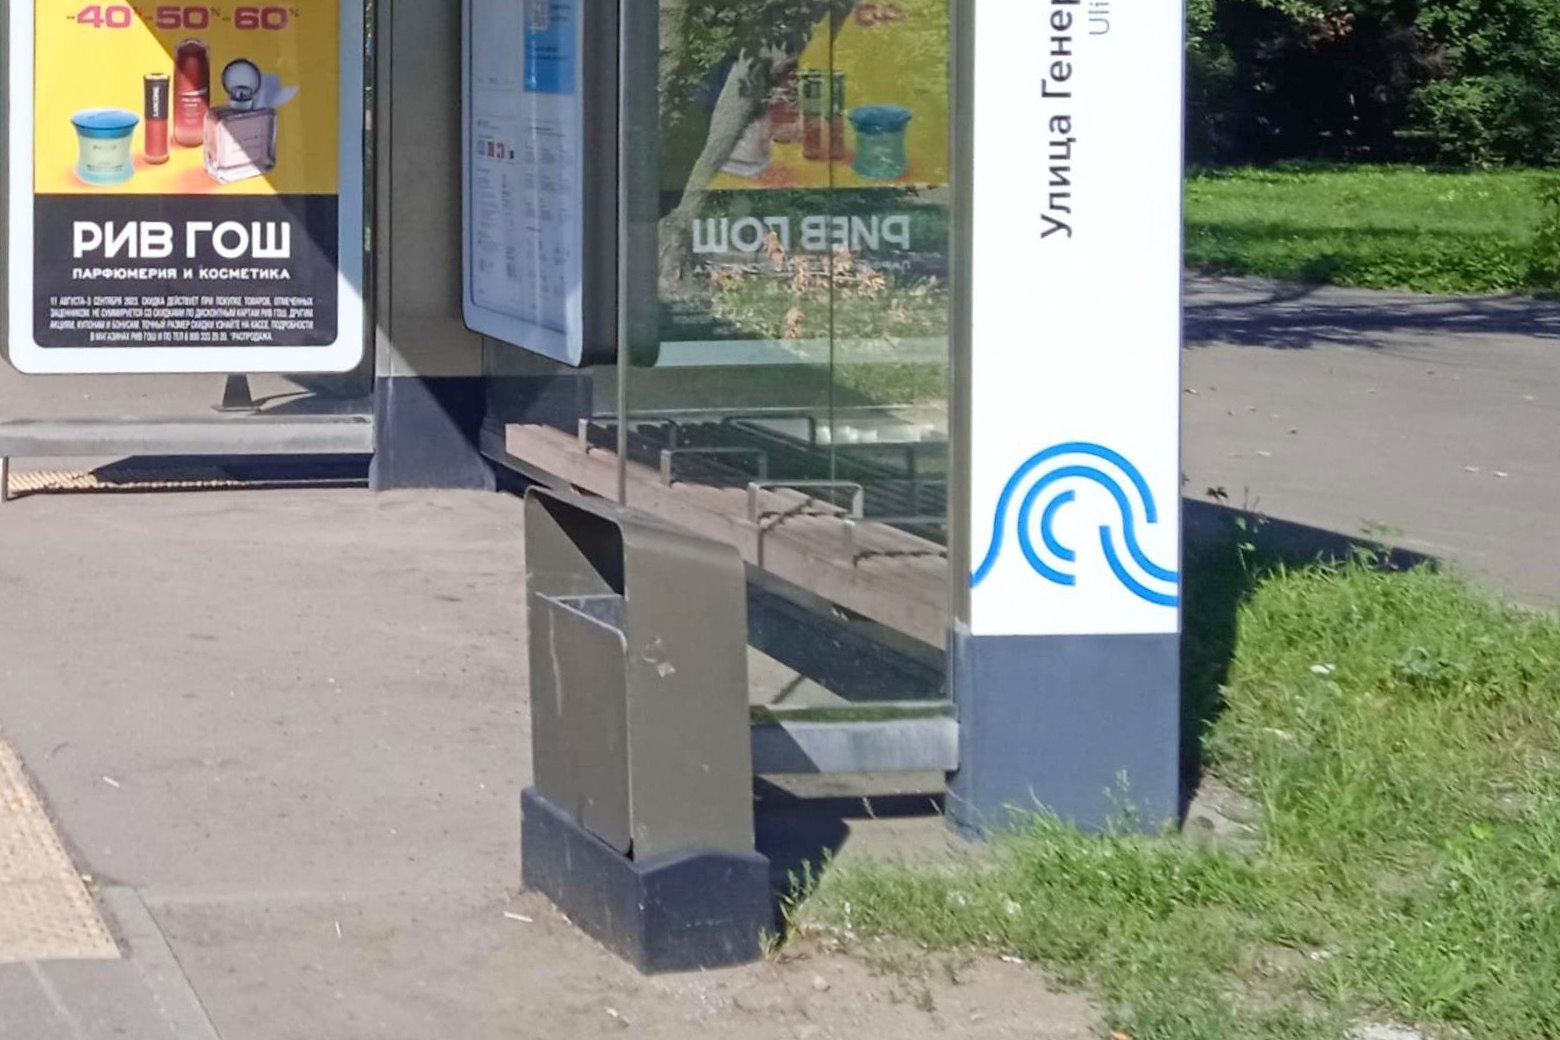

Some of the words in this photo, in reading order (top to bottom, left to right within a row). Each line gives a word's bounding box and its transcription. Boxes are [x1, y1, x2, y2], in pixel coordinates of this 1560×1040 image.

[1040, 115, 1076, 238] Улица
[73, 221, 173, 258] РИВ
[186, 221, 290, 258] ГОШ
[72, 267, 177, 279] ПАРФЮМЕРИЯ
[183, 268, 192, 279] И
[199, 267, 290, 279] КОСМЕТИКА
